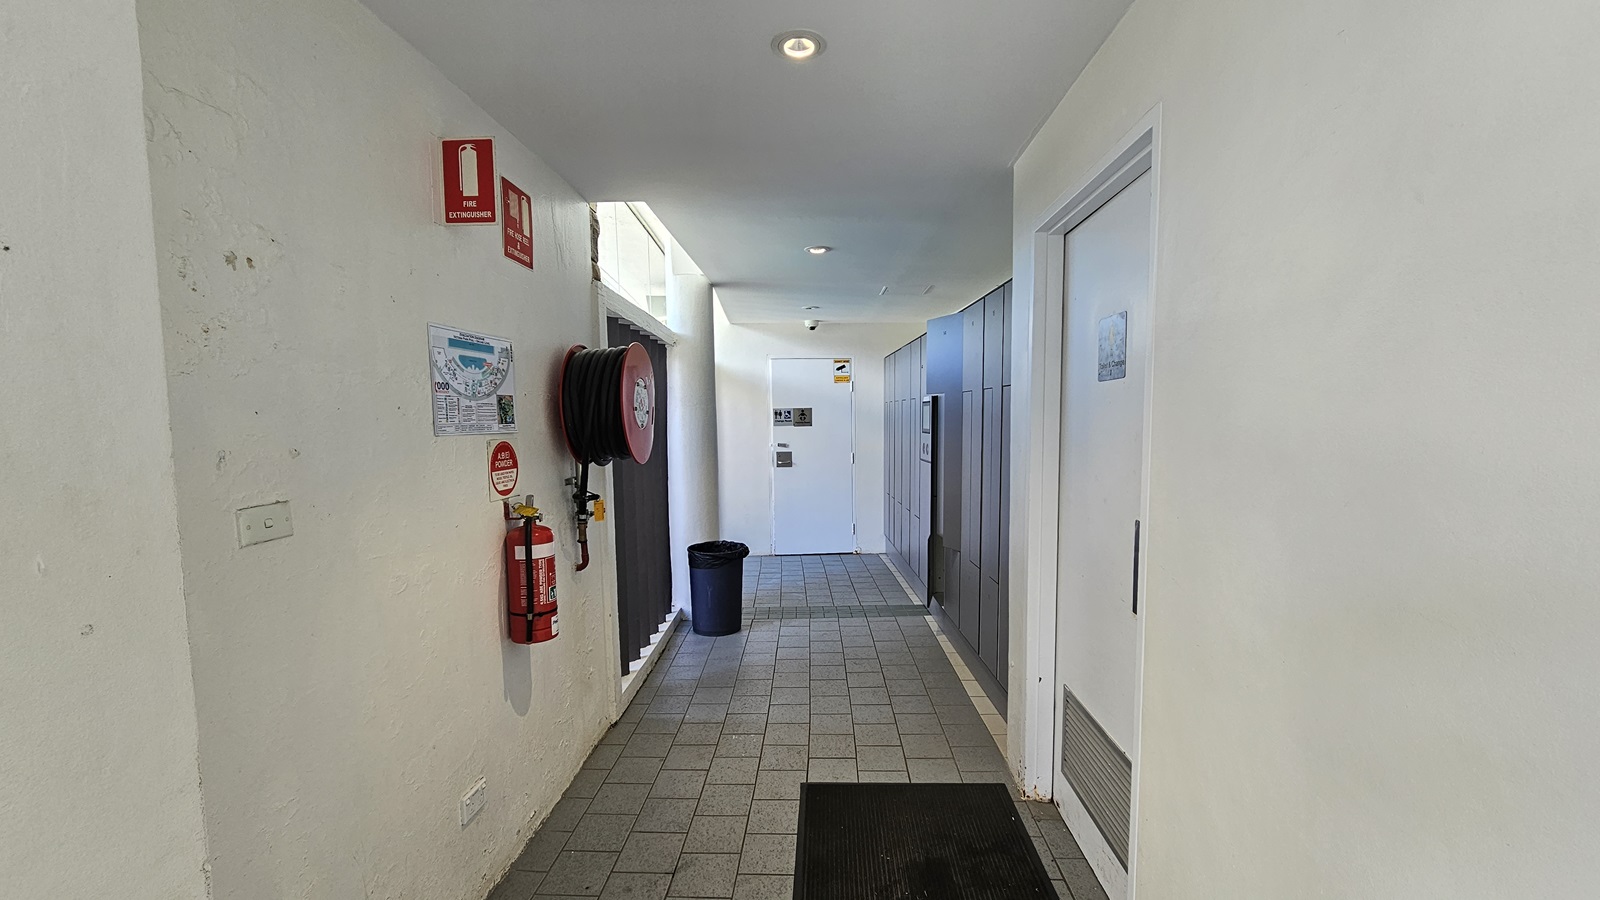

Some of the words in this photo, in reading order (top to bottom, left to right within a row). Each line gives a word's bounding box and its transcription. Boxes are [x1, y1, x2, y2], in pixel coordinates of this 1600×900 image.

[463, 200, 477, 208] FIRE
[448, 211, 492, 219] EXTINGUISHER
[508, 246, 530, 263] EXTINGUISHER
[437, 381, 450, 391] 000
[495, 460, 513, 469] POWDER
